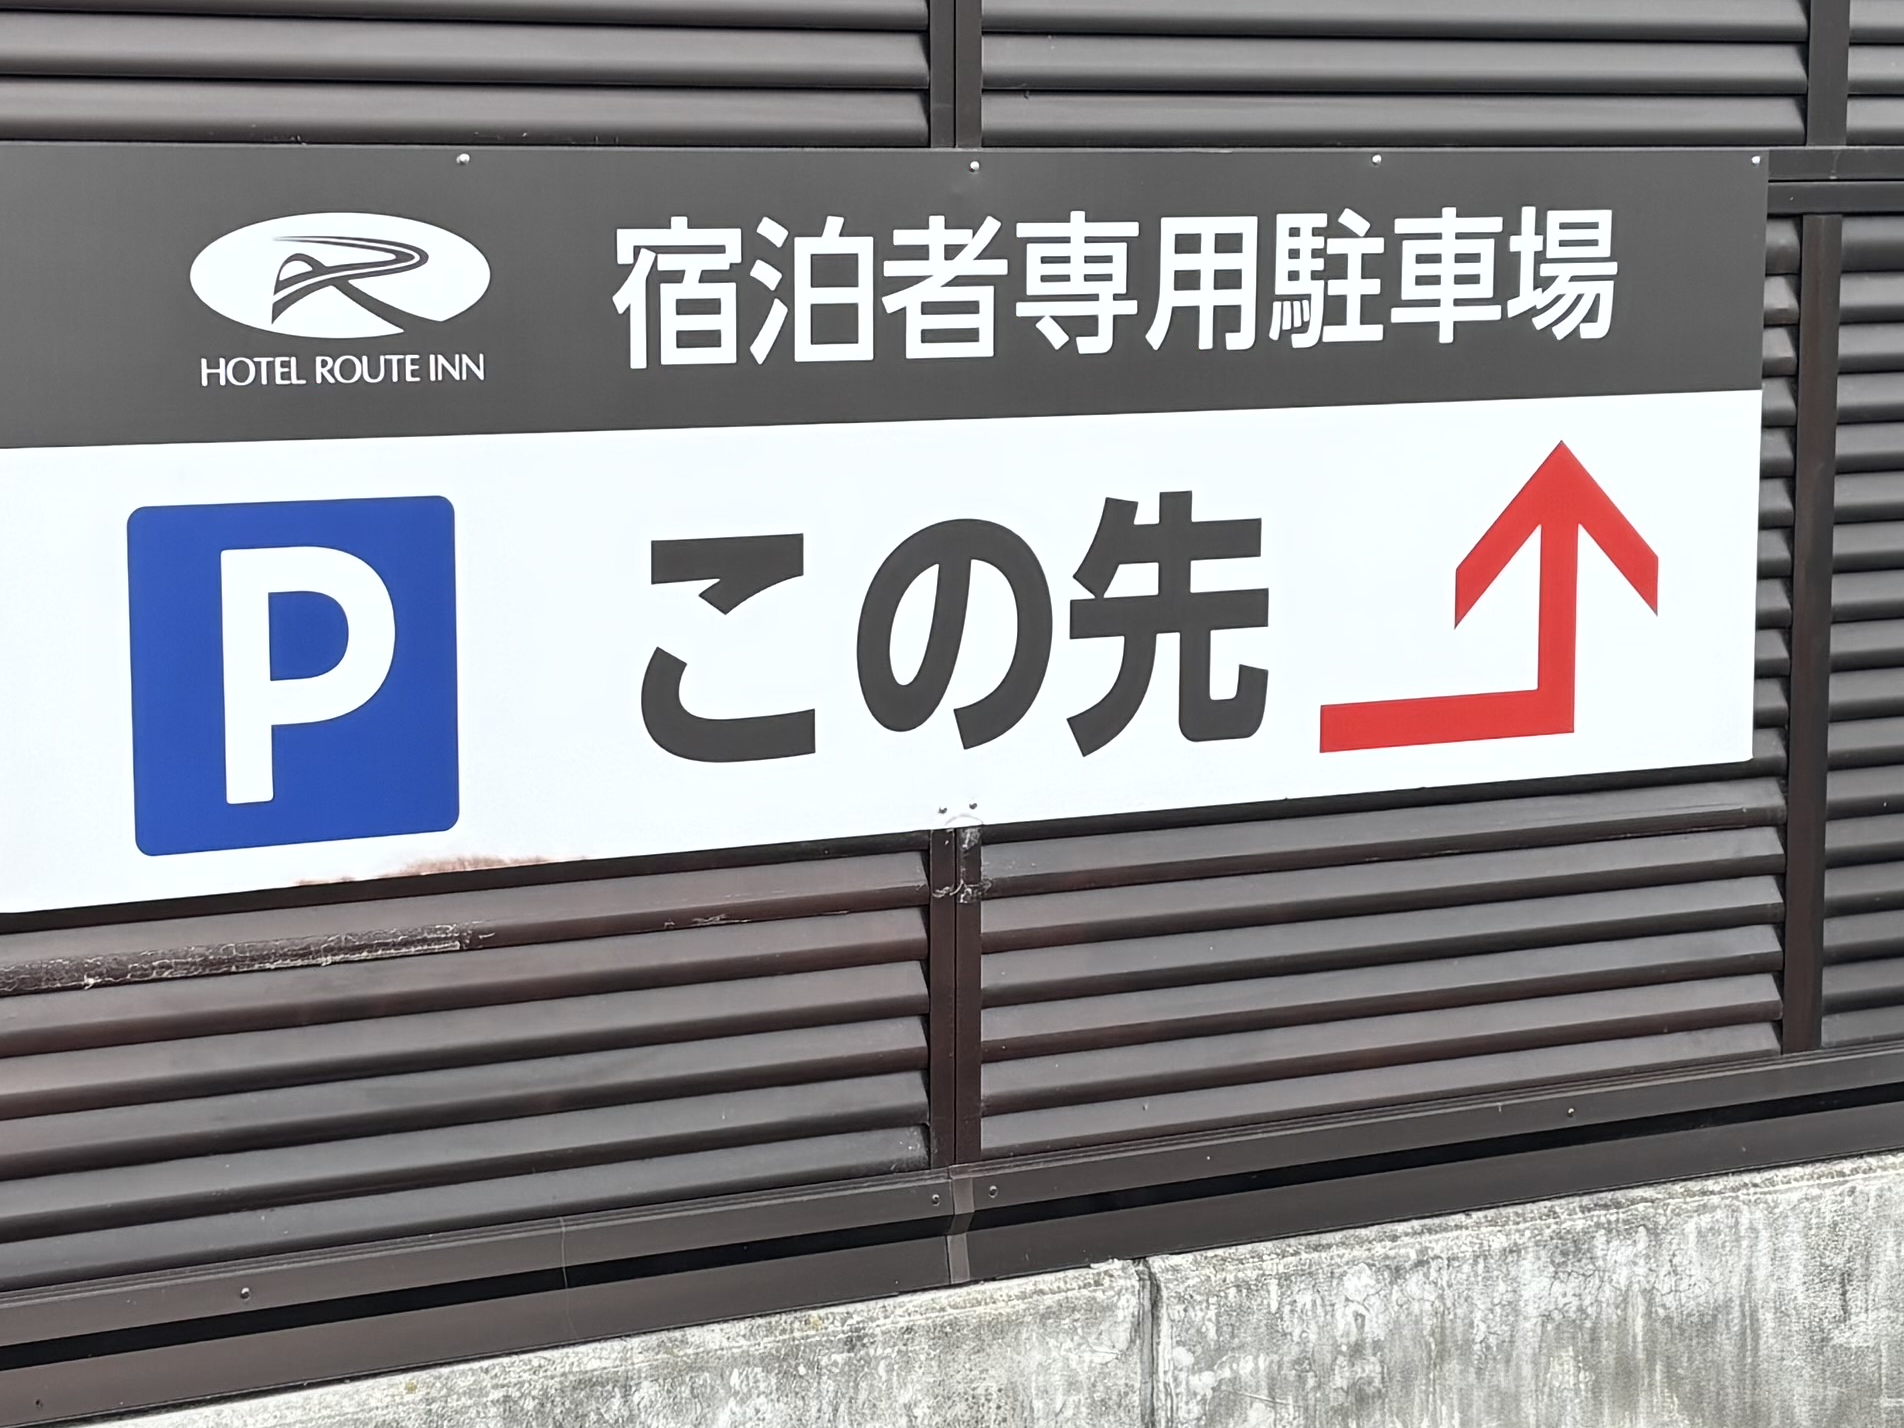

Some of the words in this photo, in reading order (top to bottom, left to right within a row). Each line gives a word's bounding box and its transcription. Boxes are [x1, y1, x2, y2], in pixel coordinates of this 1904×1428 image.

[200, 355, 307, 387] HOTEL
[315, 354, 421, 385] ROUTE
[429, 353, 485, 383] INN
[612, 205, 1618, 370] 宿泊者専用駐車場
[220, 546, 396, 805] P
[641, 490, 1269, 763] この先
